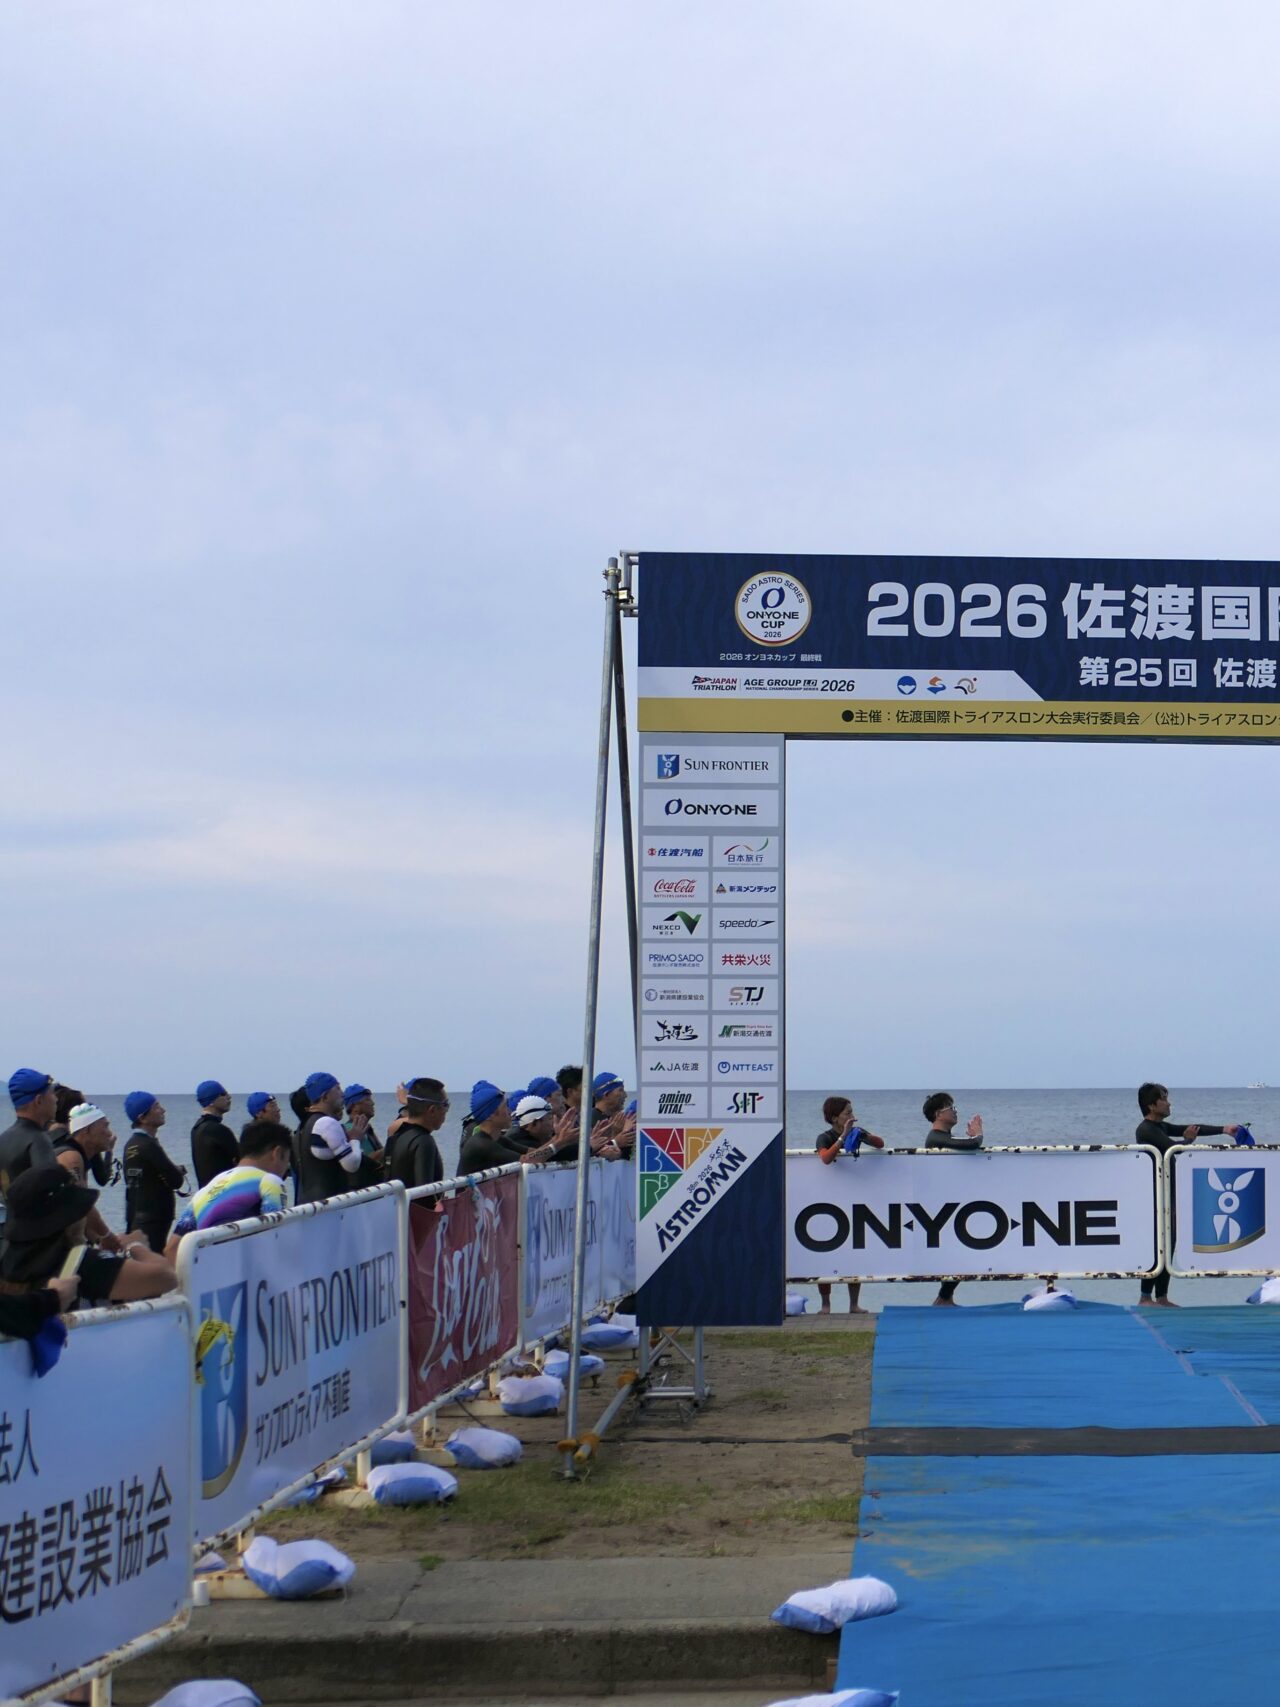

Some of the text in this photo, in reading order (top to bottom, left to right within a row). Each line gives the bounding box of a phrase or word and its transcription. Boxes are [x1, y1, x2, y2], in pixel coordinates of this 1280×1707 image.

[741, 576, 805, 604] SADO ASTRO SERIES
[867, 581, 1047, 638] 2026
[761, 621, 785, 629] CUP
[720, 653, 743, 661] 2026
[744, 653, 796, 662] オンヨネカップ
[1079, 656, 1197, 688] 第25回
[767, 679, 801, 687] GROUP
[821, 679, 855, 692] 2026
[684, 758, 769, 771] SUN FRONTIER
[657, 848, 704, 857] 佐渡汽船
[728, 854, 764, 863] 日本旅行
[729, 885, 777, 893] 新潟メンテック
[719, 918, 758, 930] speedo
[648, 953, 704, 962] PRIMO SADO
[722, 954, 771, 967] 共栄火災
[728, 986, 764, 1002] STJ
[732, 1063, 774, 1071] NTT EAST
[658, 1090, 692, 1103] amino
[658, 1103, 684, 1114] VITAL
[698, 1164, 713, 1181] 2026
[655, 1147, 748, 1253] ASTROMAN
[256, 1251, 397, 1387] SUN FRONTIER
[255, 1367, 352, 1466] サンフロンティア不動産
